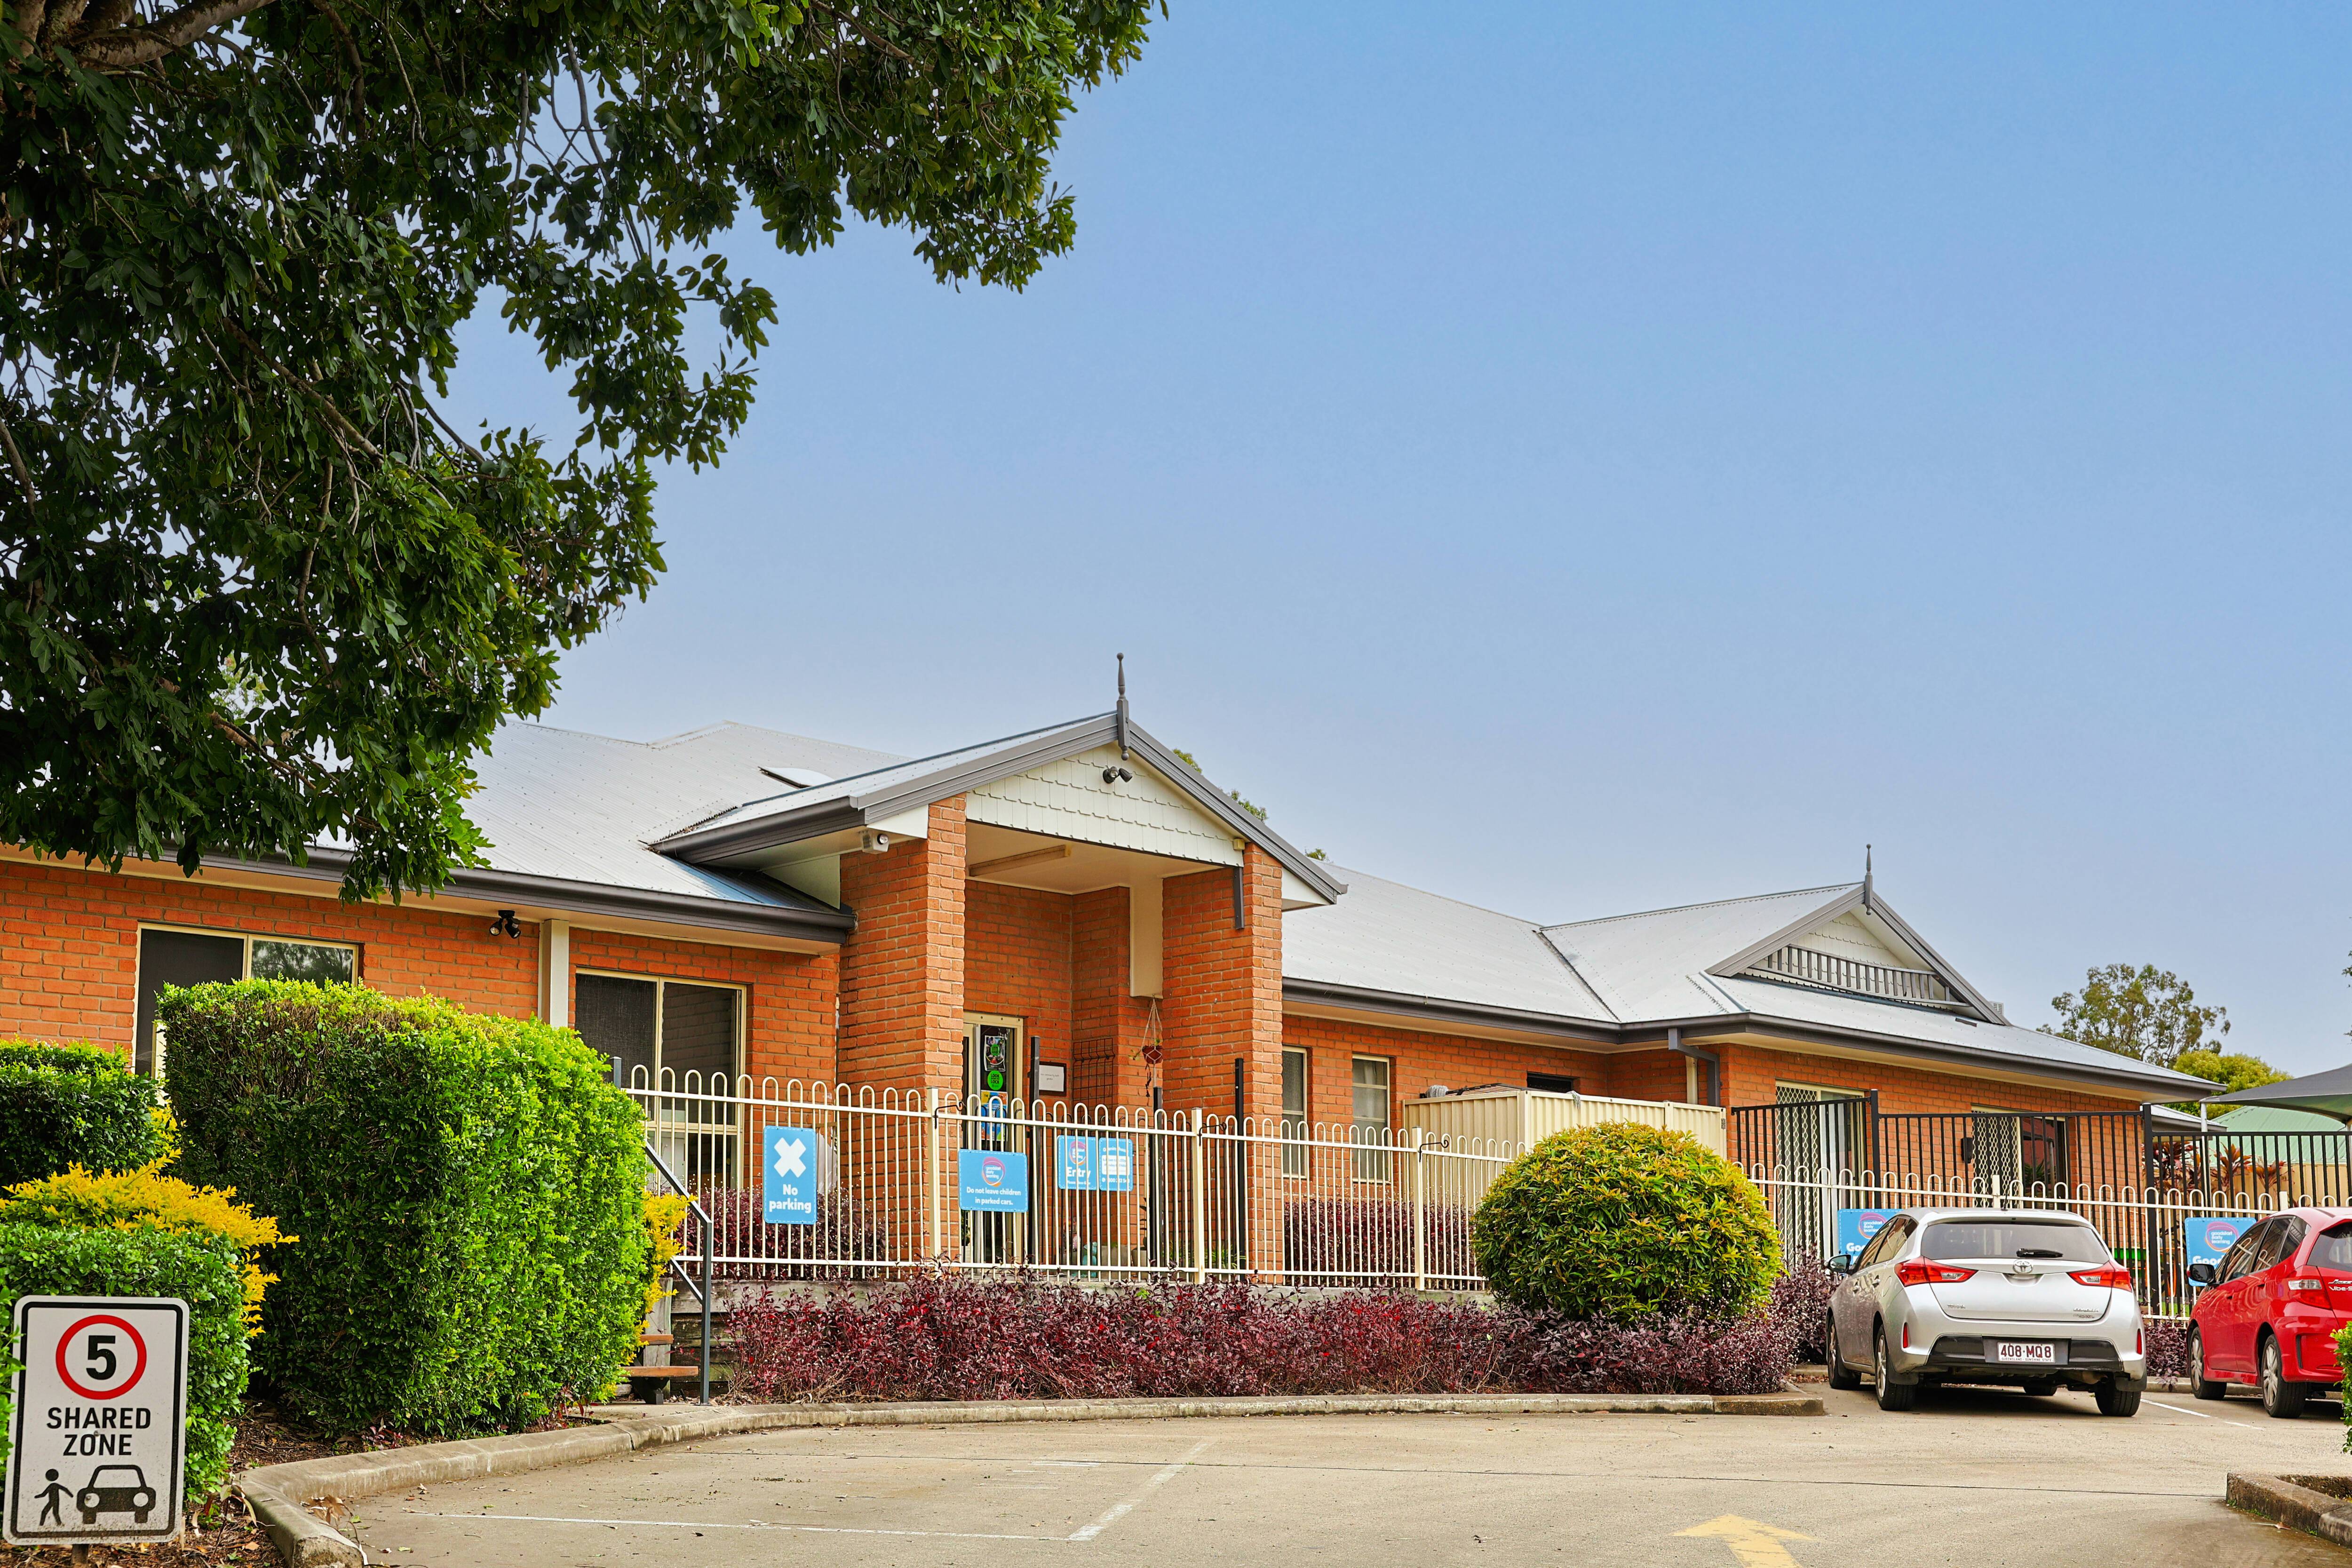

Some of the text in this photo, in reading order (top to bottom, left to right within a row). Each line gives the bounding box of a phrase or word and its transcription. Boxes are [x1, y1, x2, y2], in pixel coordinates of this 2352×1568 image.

[783, 1184, 798, 1195] No
[769, 1198, 811, 1214] parking
[86, 1335, 117, 1380] 5
[47, 1407, 151, 1430] SHARED
[63, 1434, 132, 1457] ZONE
